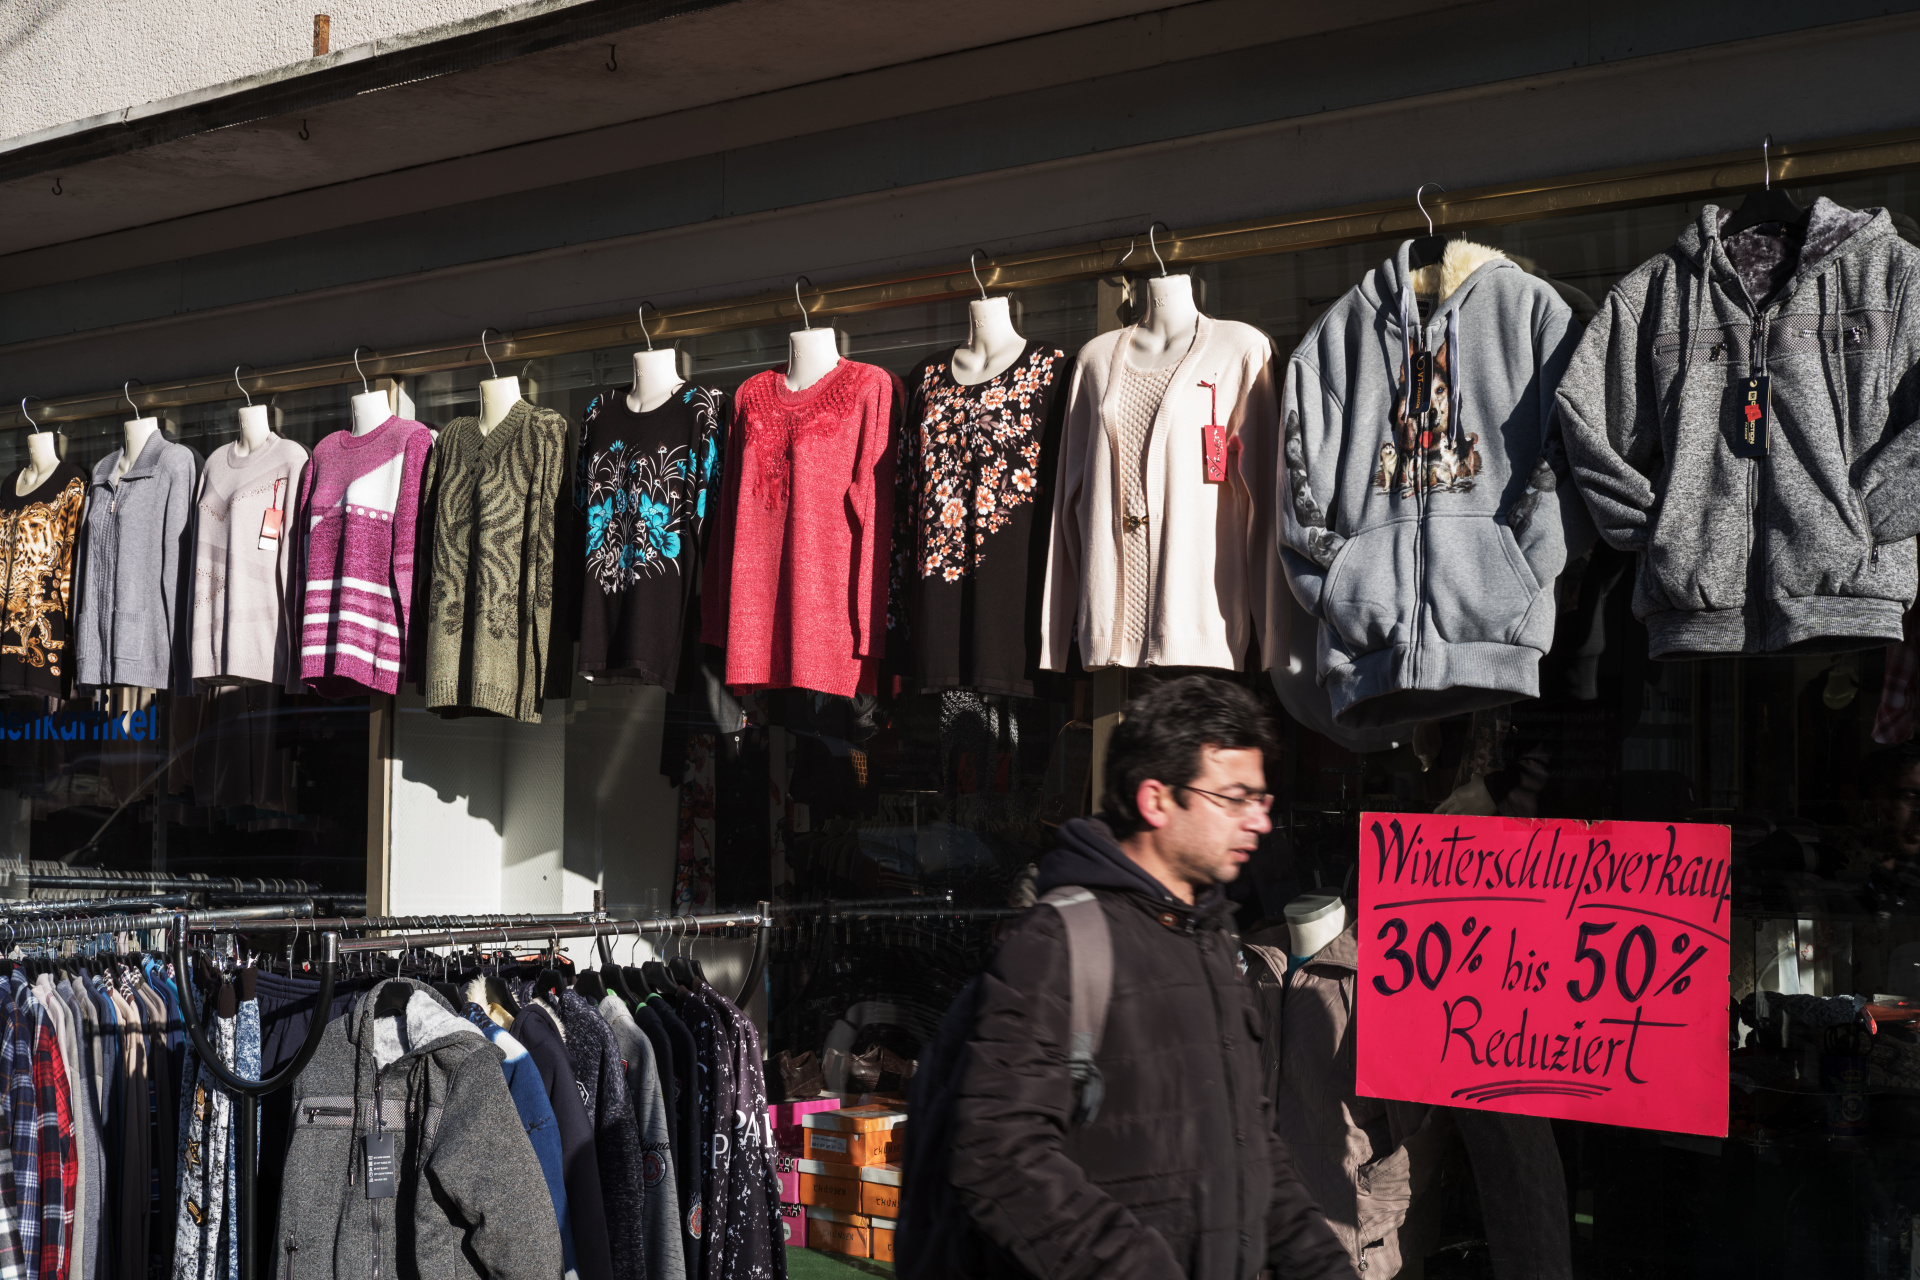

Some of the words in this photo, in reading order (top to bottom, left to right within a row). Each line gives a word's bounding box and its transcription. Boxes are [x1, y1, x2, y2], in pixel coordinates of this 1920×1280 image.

[1372, 917, 1491, 996] 30%
[1502, 928, 1549, 992] bis
[1567, 922, 1708, 1003] 50%
[1441, 996, 1687, 1084] Reduziert
